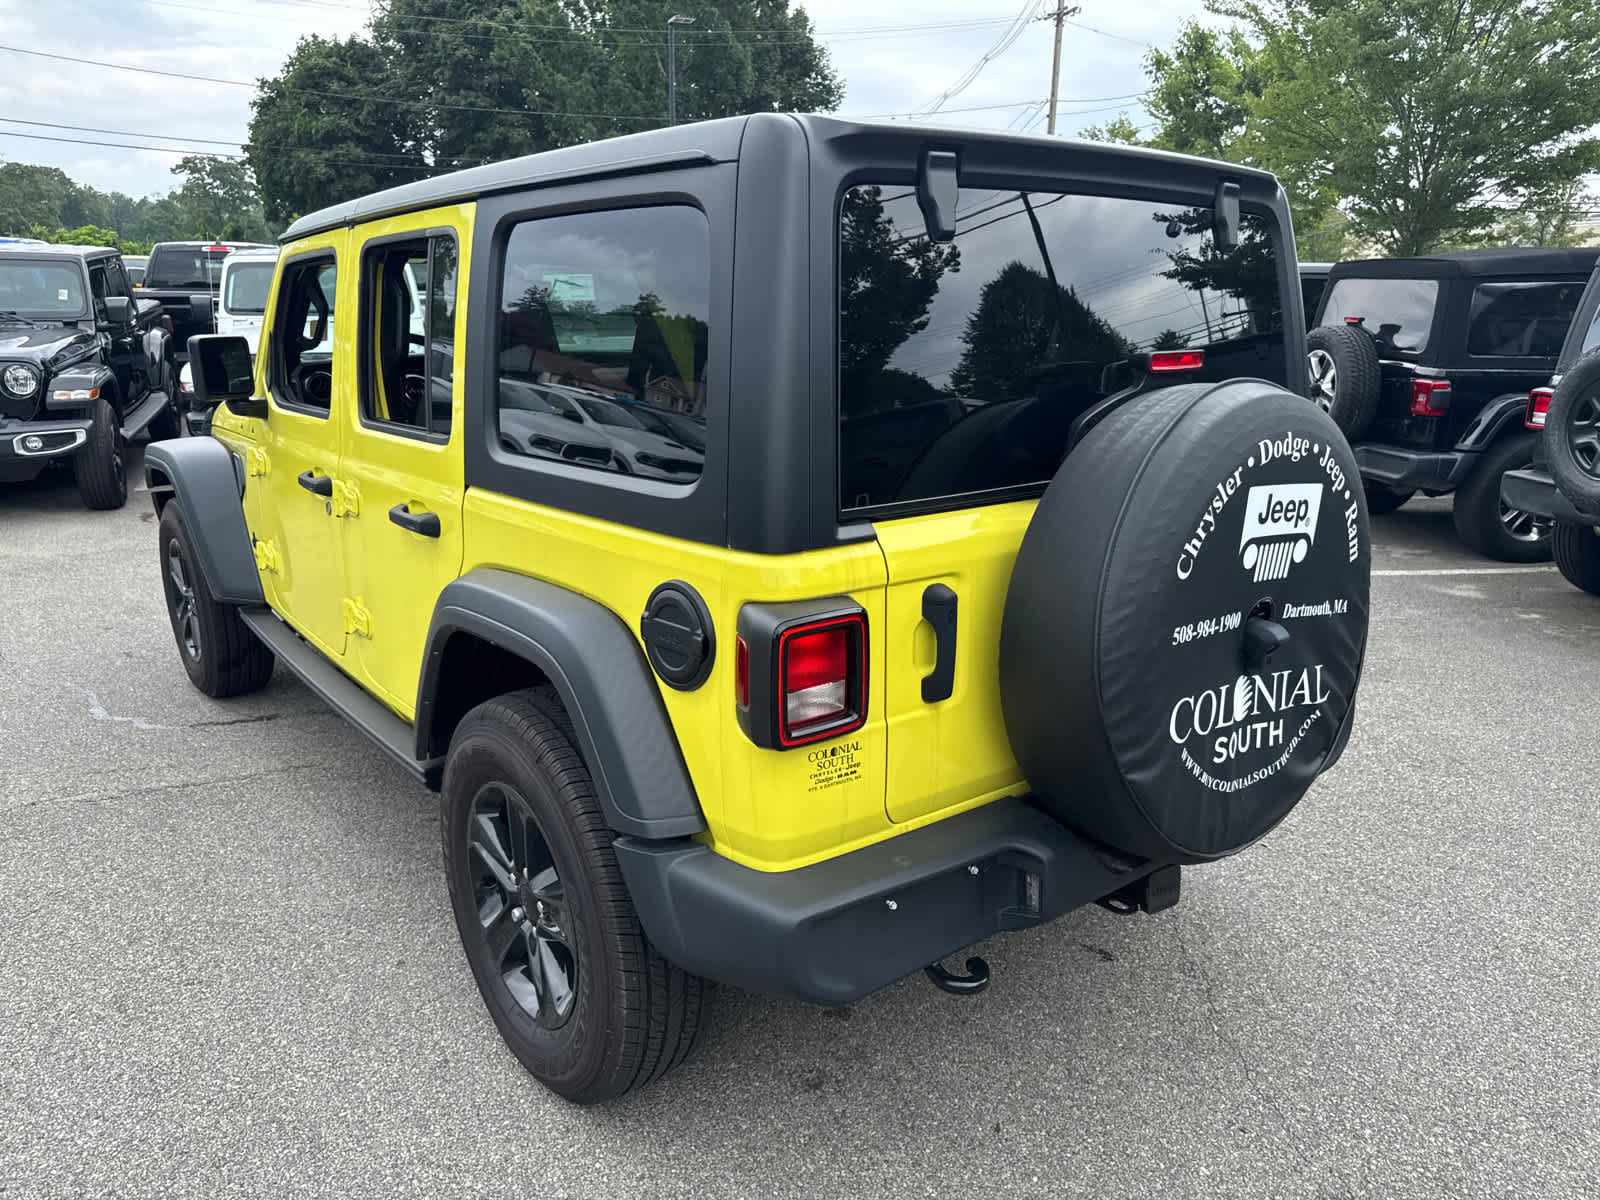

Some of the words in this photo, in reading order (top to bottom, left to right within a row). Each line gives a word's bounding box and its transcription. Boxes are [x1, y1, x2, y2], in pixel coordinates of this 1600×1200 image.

[1176, 466, 1243, 580] Chrysler
[1258, 432, 1310, 466] Dodge
[1319, 445, 1346, 493] Jeep
[1344, 500, 1359, 563] Ram
[1258, 493, 1309, 528] Jeep
[1282, 601, 1332, 618] Dartmouth,
[1333, 599, 1348, 613] MA
[1172, 612, 1241, 646] 508-984-1900
[1169, 664, 1331, 744] COLONIAL
[808, 741, 862, 763] COLONIAL
[1213, 718, 1284, 764] SOUTH
[817, 753, 854, 771] SOUTH
